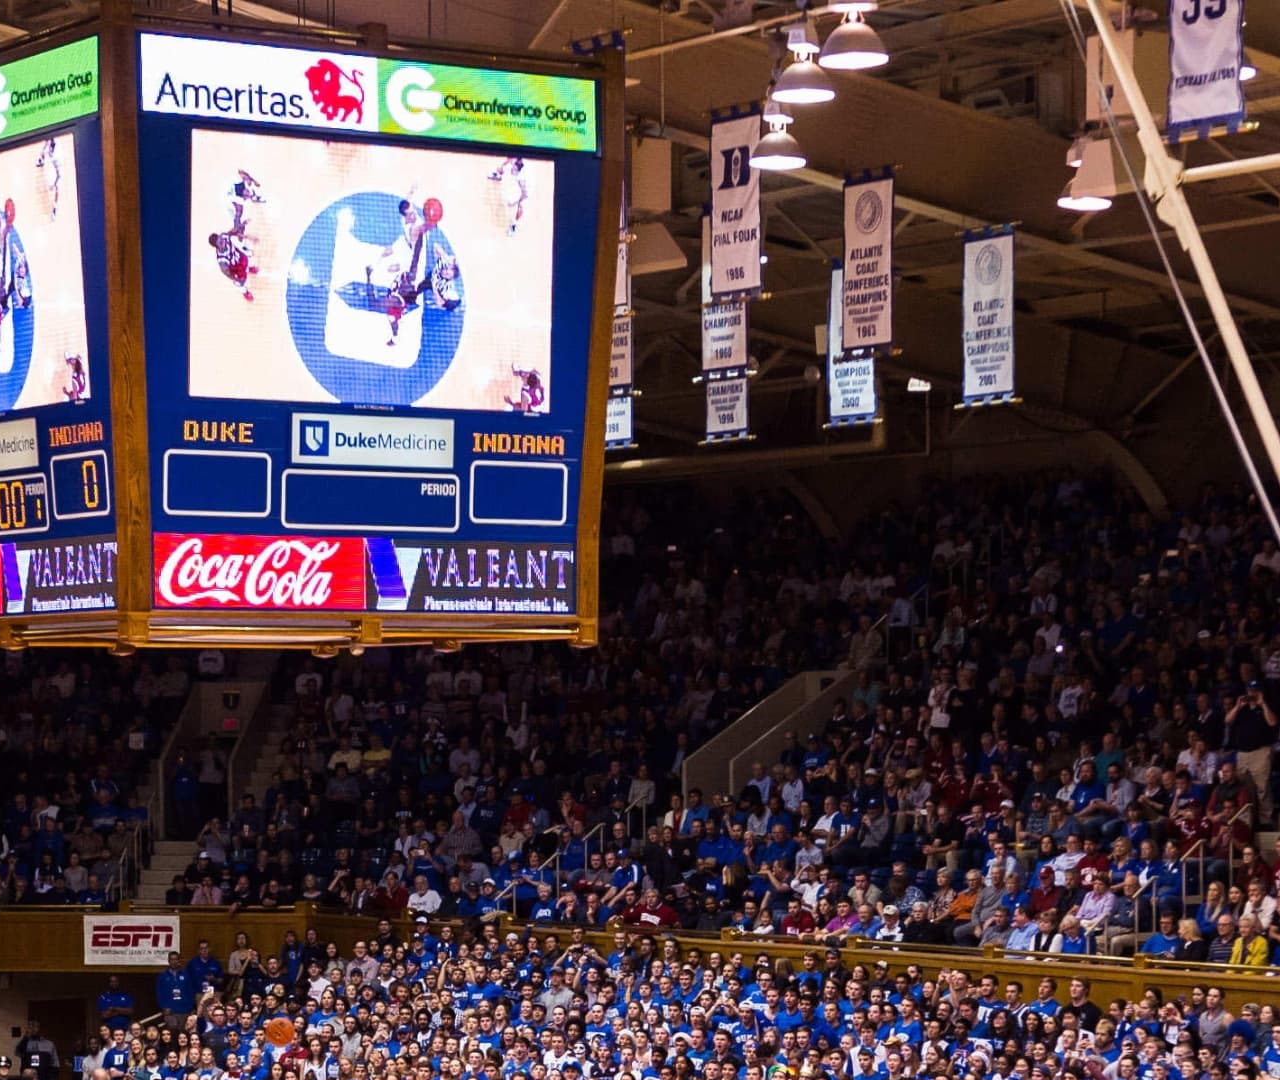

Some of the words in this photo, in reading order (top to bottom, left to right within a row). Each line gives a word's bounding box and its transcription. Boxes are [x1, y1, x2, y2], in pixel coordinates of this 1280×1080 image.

[66, 70, 93, 90] Group
[444, 95, 542, 119] Circumference
[545, 105, 588, 124] Group
[721, 208, 744, 223] NCAA
[733, 227, 758, 247] FOUR
[850, 245, 883, 259] ATLANTIC
[856, 261, 878, 275] COAST
[845, 274, 889, 291] CONFERENCE
[845, 291, 887, 306] CHAMPIONS
[704, 314, 742, 330] CHAMPIONS
[977, 313, 998, 327] COAST
[965, 326, 1012, 342] CONFERENCE
[967, 342, 1009, 357] CHAMPIONS
[979, 374, 997, 386] 2001
[49, 421, 103, 447] INDIANA
[184, 420, 254, 444] DUKE
[472, 432, 565, 456] INDIANA
[25, 482, 45, 495] PERIOD
[82, 460, 99, 508] 0
[421, 483, 456, 497] PERIOD
[36, 499, 42, 520] 1
[30, 542, 118, 587] VALEANT
[159, 537, 340, 606] Coca-Cola
[423, 547, 574, 590] VALEANT
[91, 925, 173, 947] ESPN
